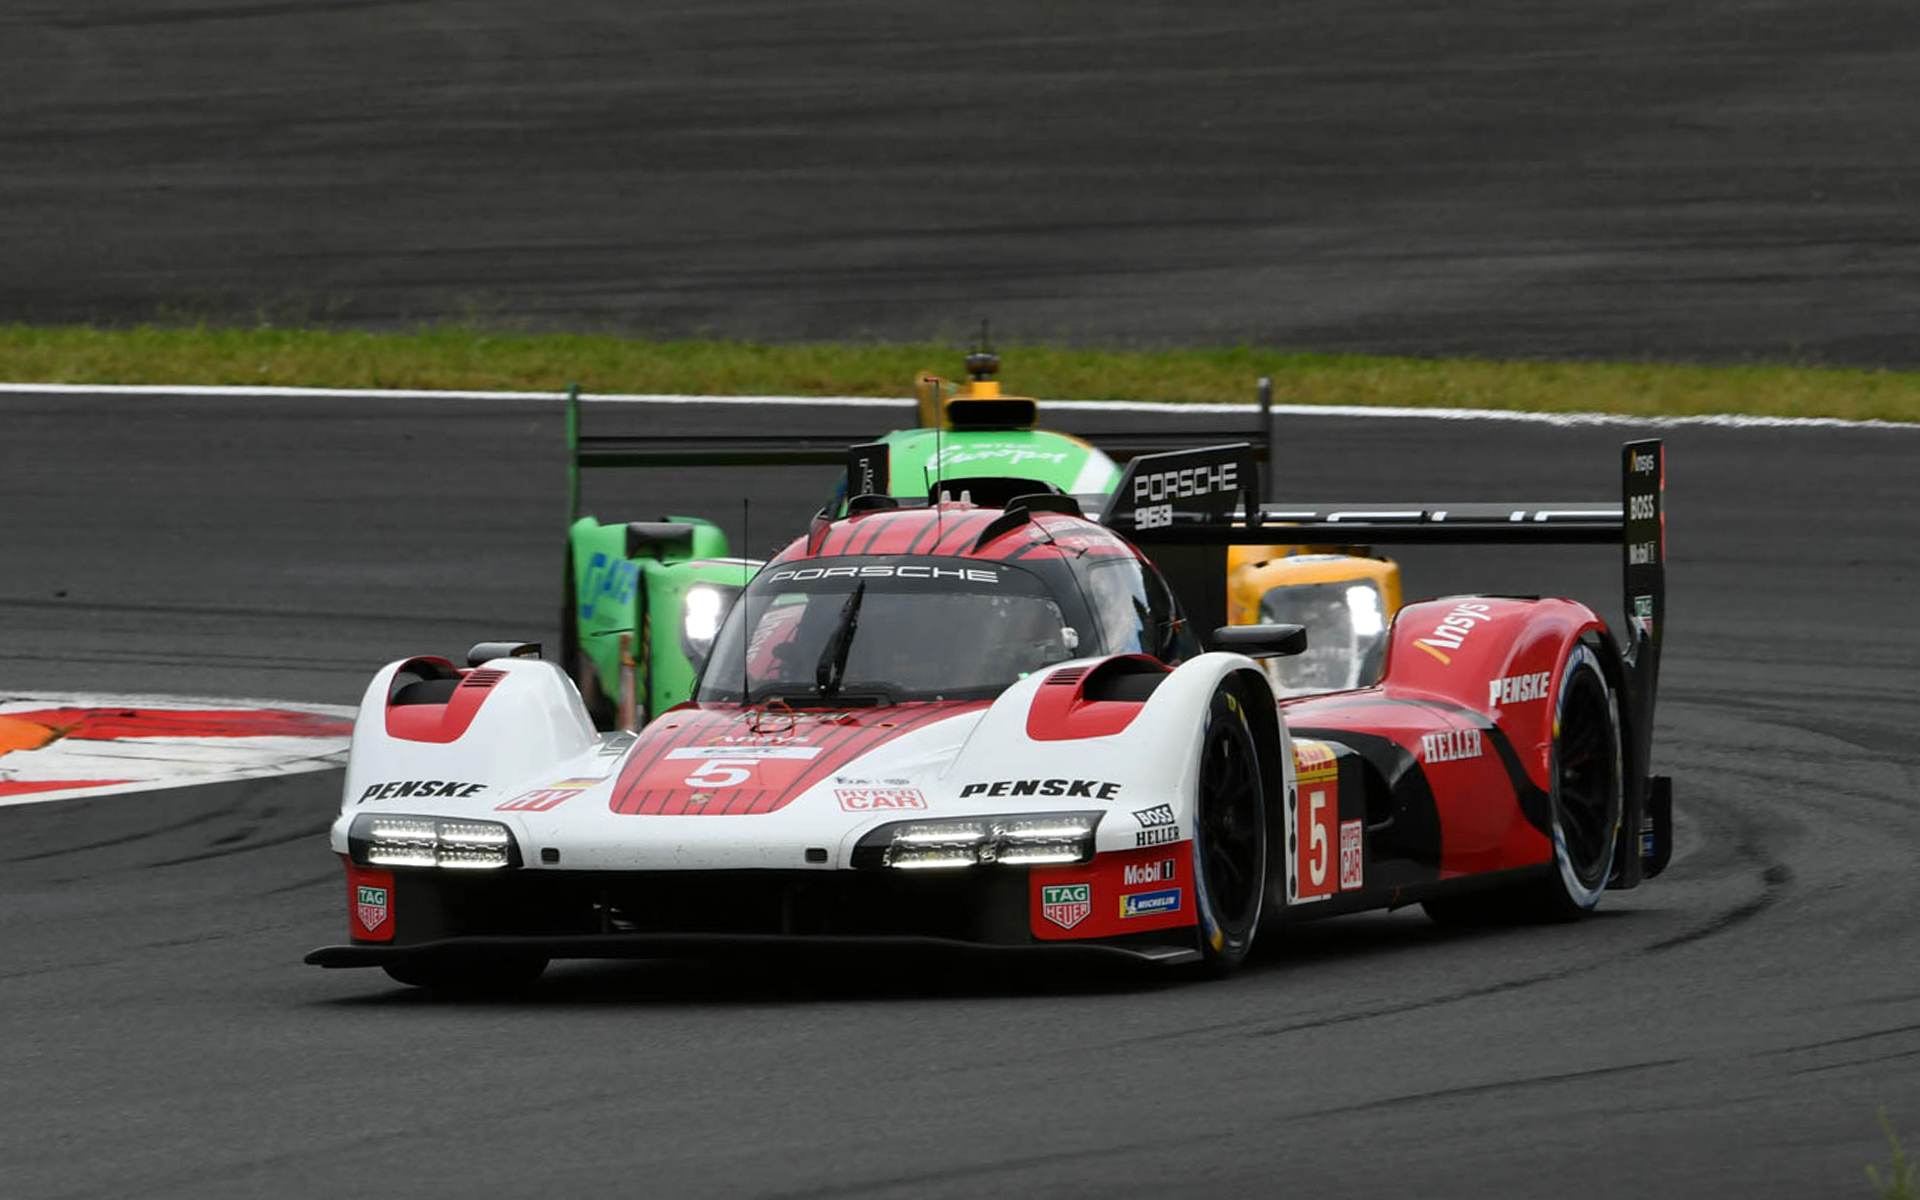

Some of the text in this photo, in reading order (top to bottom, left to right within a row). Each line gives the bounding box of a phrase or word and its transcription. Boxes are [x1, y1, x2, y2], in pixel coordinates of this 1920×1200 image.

[1630, 449, 1655, 476] Ansys
[1134, 462, 1238, 504] PORSCHE
[1630, 494, 1655, 520] BOSS
[768, 566, 999, 584] PORSCHE
[1412, 602, 1492, 667] Ansys
[1489, 671, 1551, 706] PENSKE
[1421, 729, 1483, 764] HELLER
[684, 759, 761, 788] 5
[357, 780, 489, 806] PENSKE
[841, 790, 915, 798] HYPER
[845, 797, 919, 809] CAR
[959, 779, 1122, 801] PENSKE
[1136, 806, 1174, 826] BOSS
[1135, 826, 1181, 847] HELLER
[1309, 790, 1328, 887] 5
[1123, 860, 1173, 886] Mobil 1
[1341, 848, 1362, 884] CAR
[359, 889, 384, 905] TAG
[1046, 887, 1087, 901] TAG
[1045, 903, 1088, 926] HEUER
